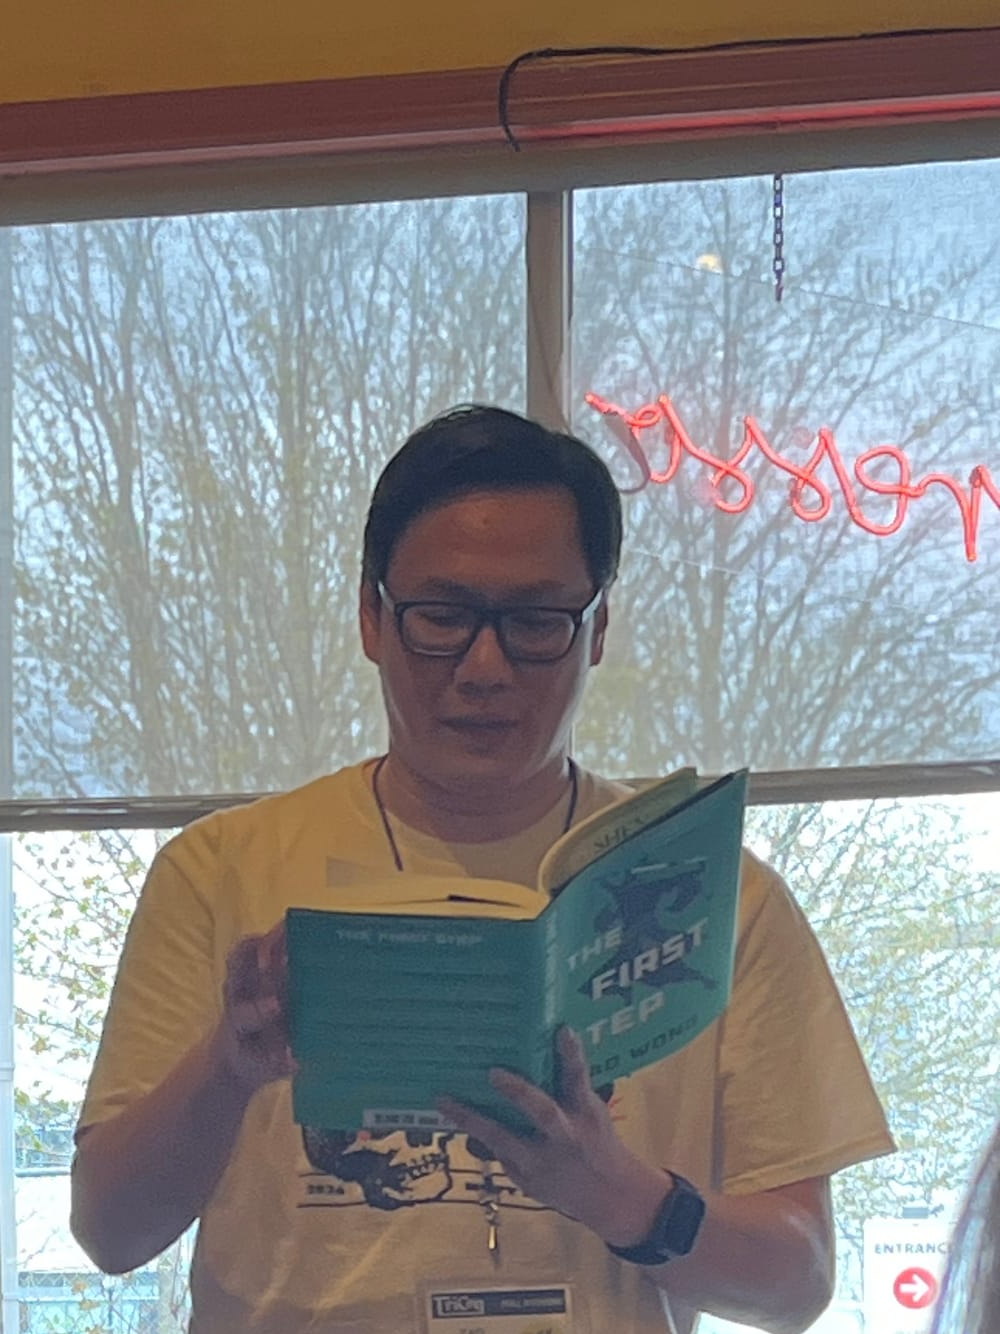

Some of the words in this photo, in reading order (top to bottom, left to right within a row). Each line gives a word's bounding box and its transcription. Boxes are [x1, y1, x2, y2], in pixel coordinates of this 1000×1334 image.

[567, 926, 623, 970] THE
[592, 916, 710, 1001] FIRST
[586, 990, 665, 1046] TEP
[874, 1242, 951, 1254] ENTRANC
